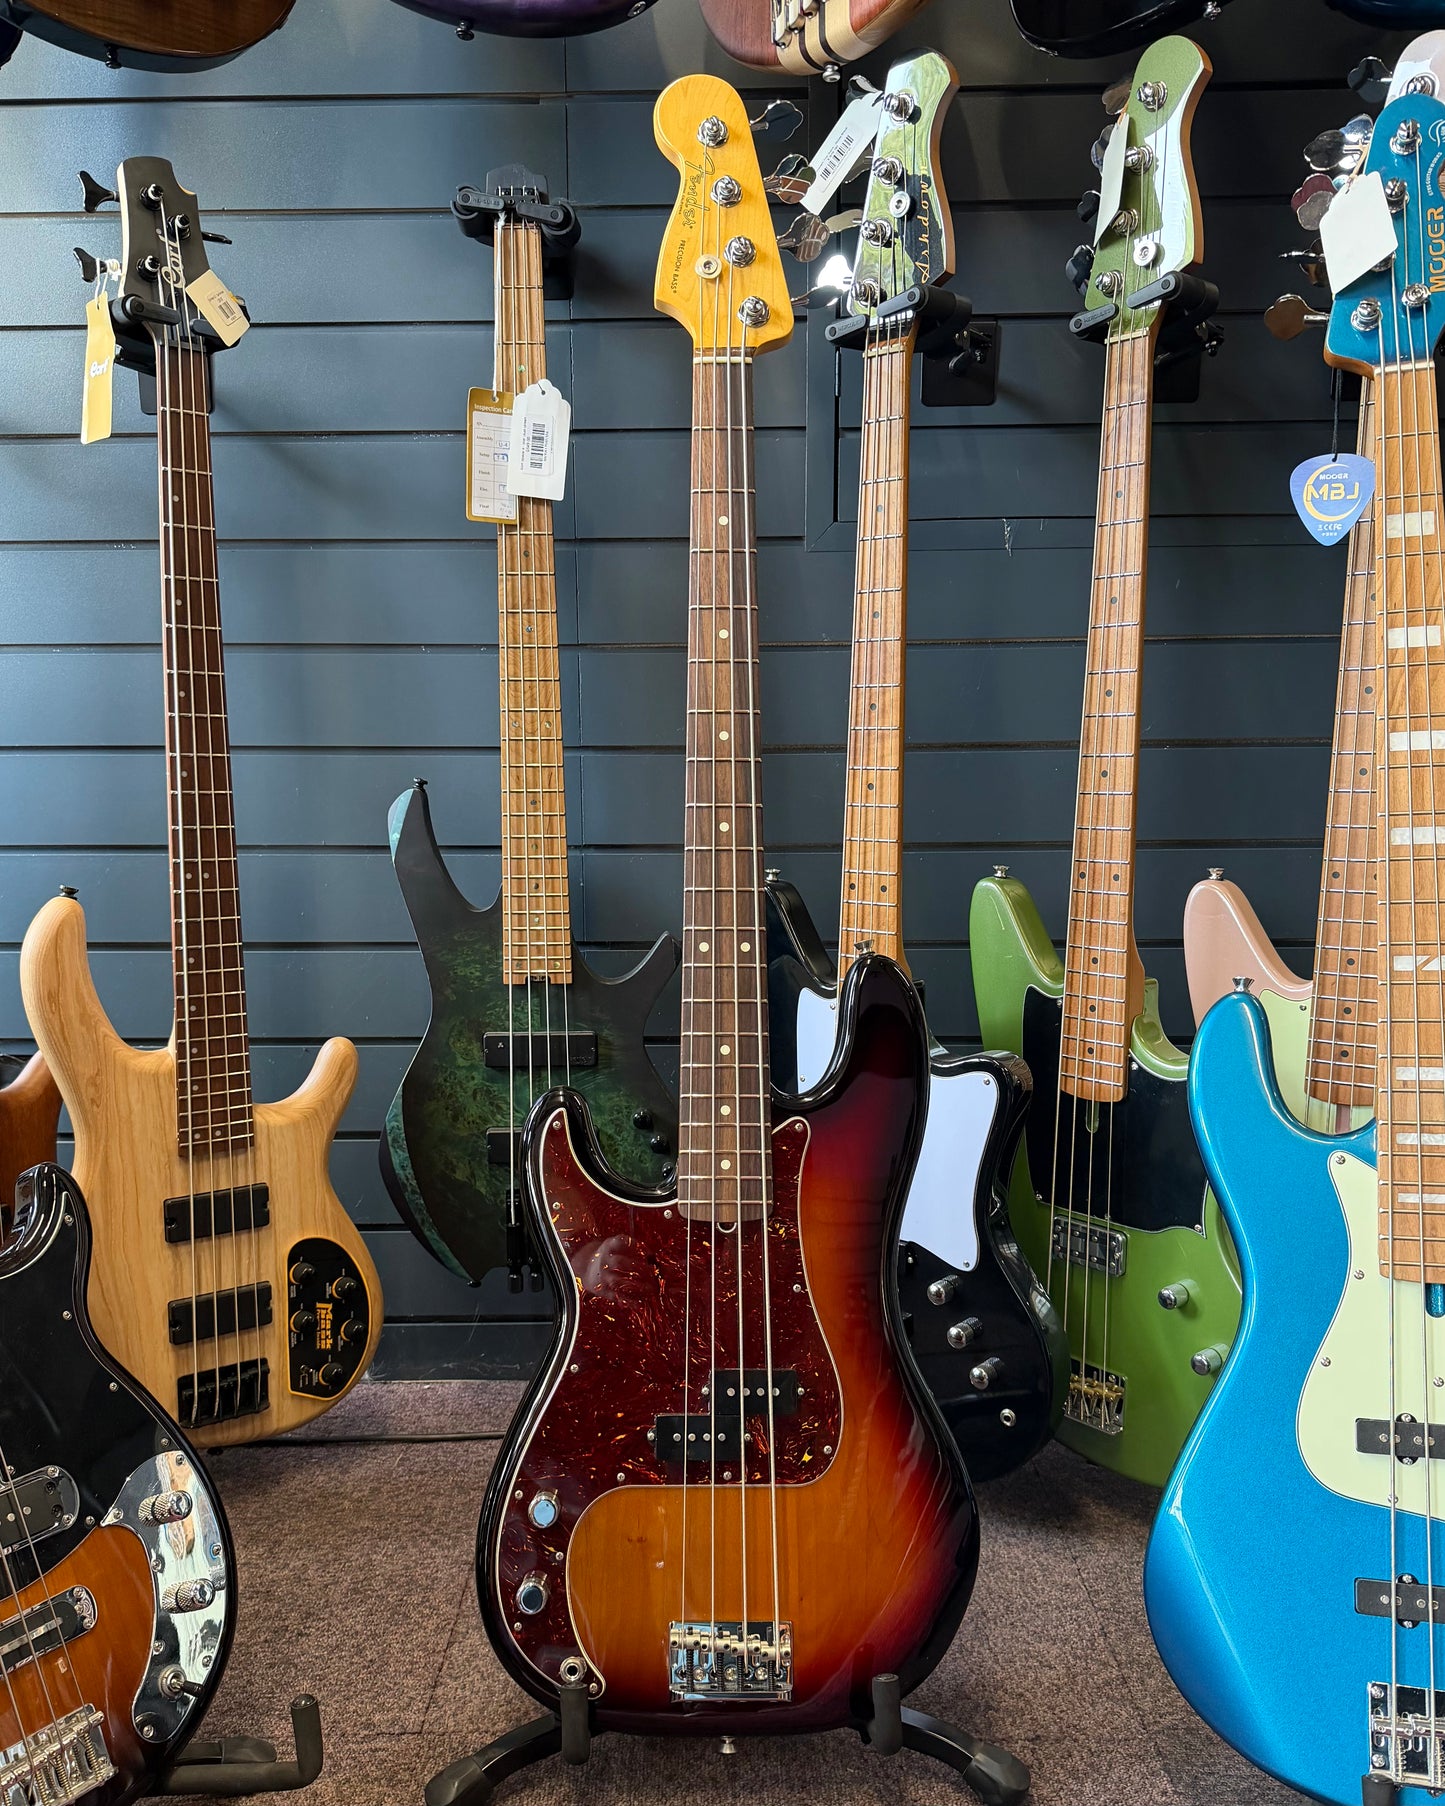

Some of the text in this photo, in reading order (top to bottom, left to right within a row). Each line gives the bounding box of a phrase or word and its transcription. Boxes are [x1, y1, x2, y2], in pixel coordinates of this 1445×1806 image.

[914, 166, 931, 284] Ashdown
[676, 239, 686, 273] PRECISION
[1427, 206, 1445, 293] MOOER
[474, 403, 502, 413] Inspection
[1306, 482, 1359, 501] MBJ
